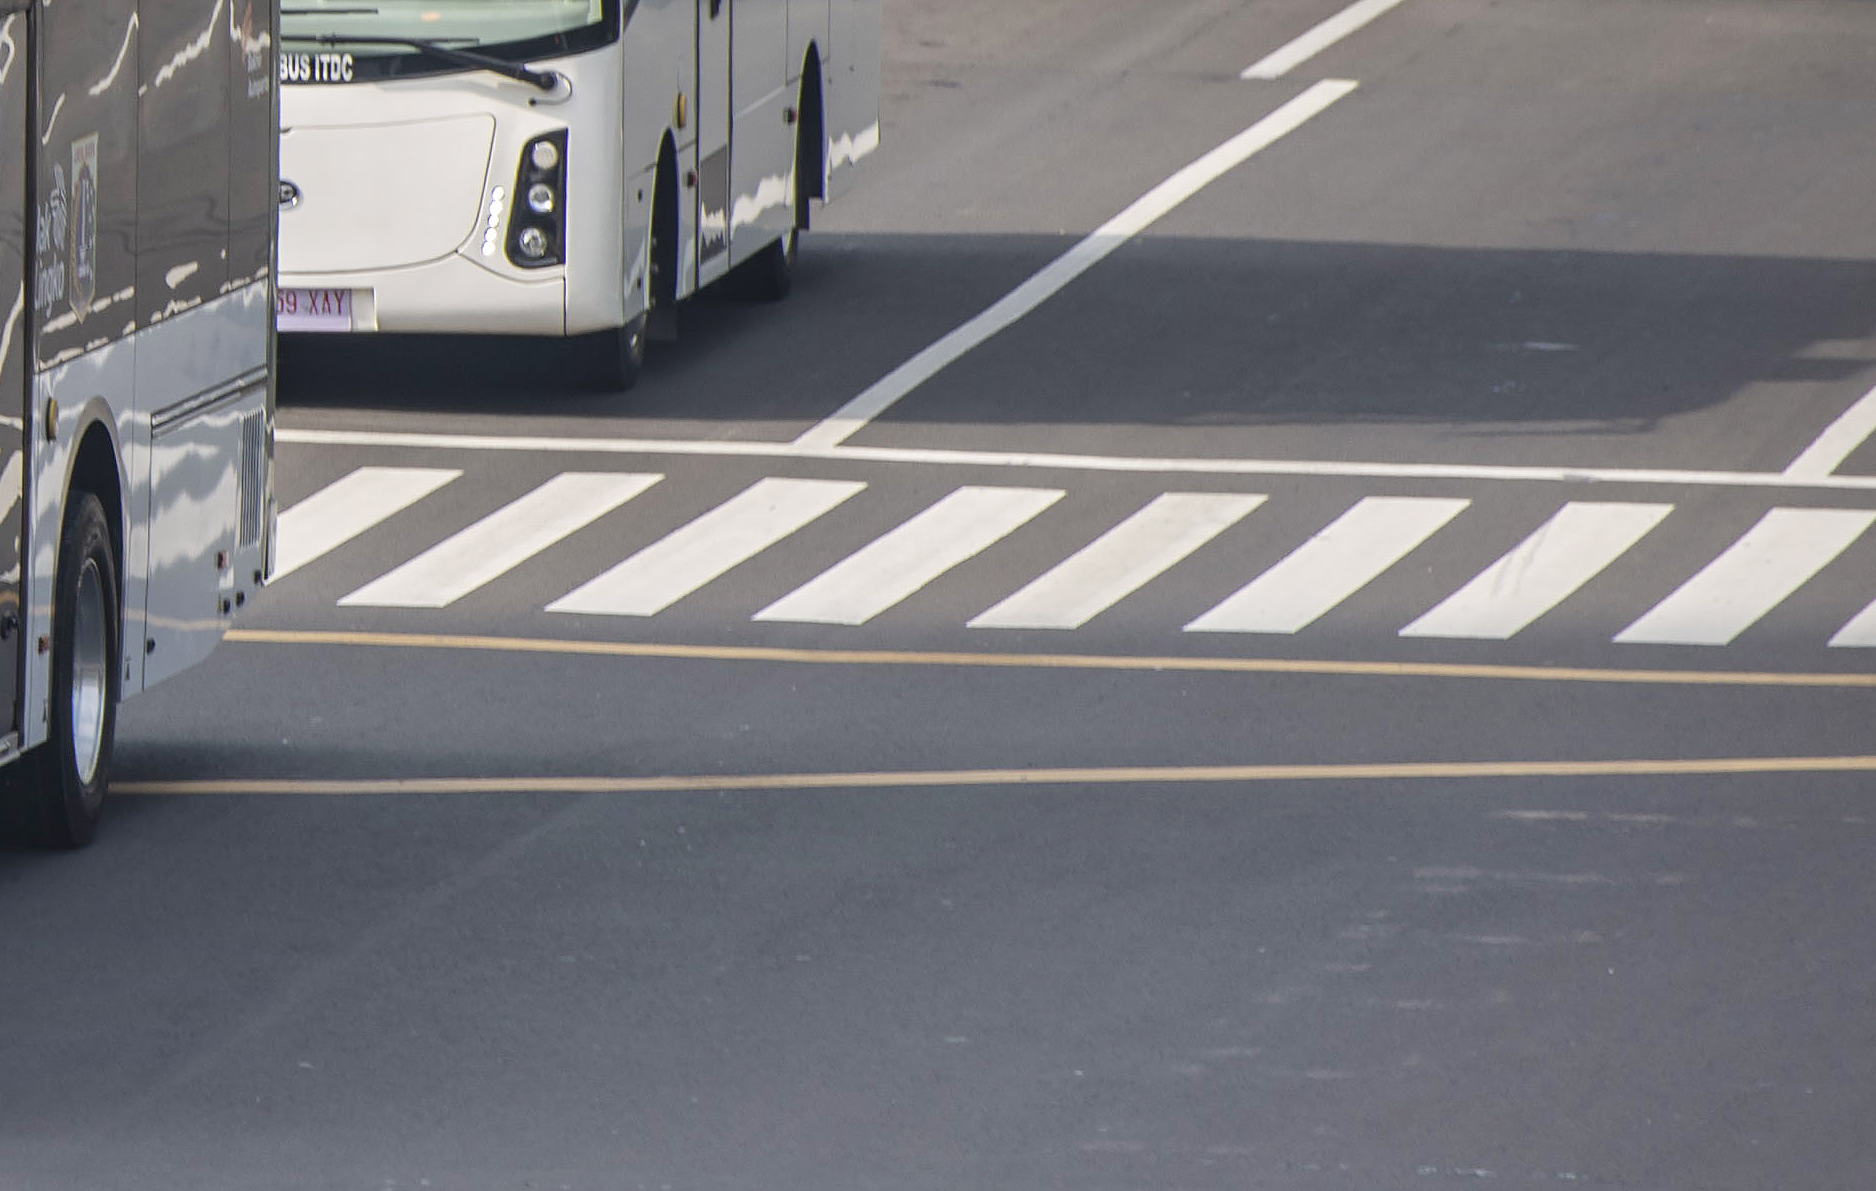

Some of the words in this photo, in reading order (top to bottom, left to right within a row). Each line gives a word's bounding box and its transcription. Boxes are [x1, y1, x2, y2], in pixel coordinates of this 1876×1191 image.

[280, 54, 311, 81] BUS
[315, 53, 353, 82] ITDC
[308, 289, 346, 316] XAY
